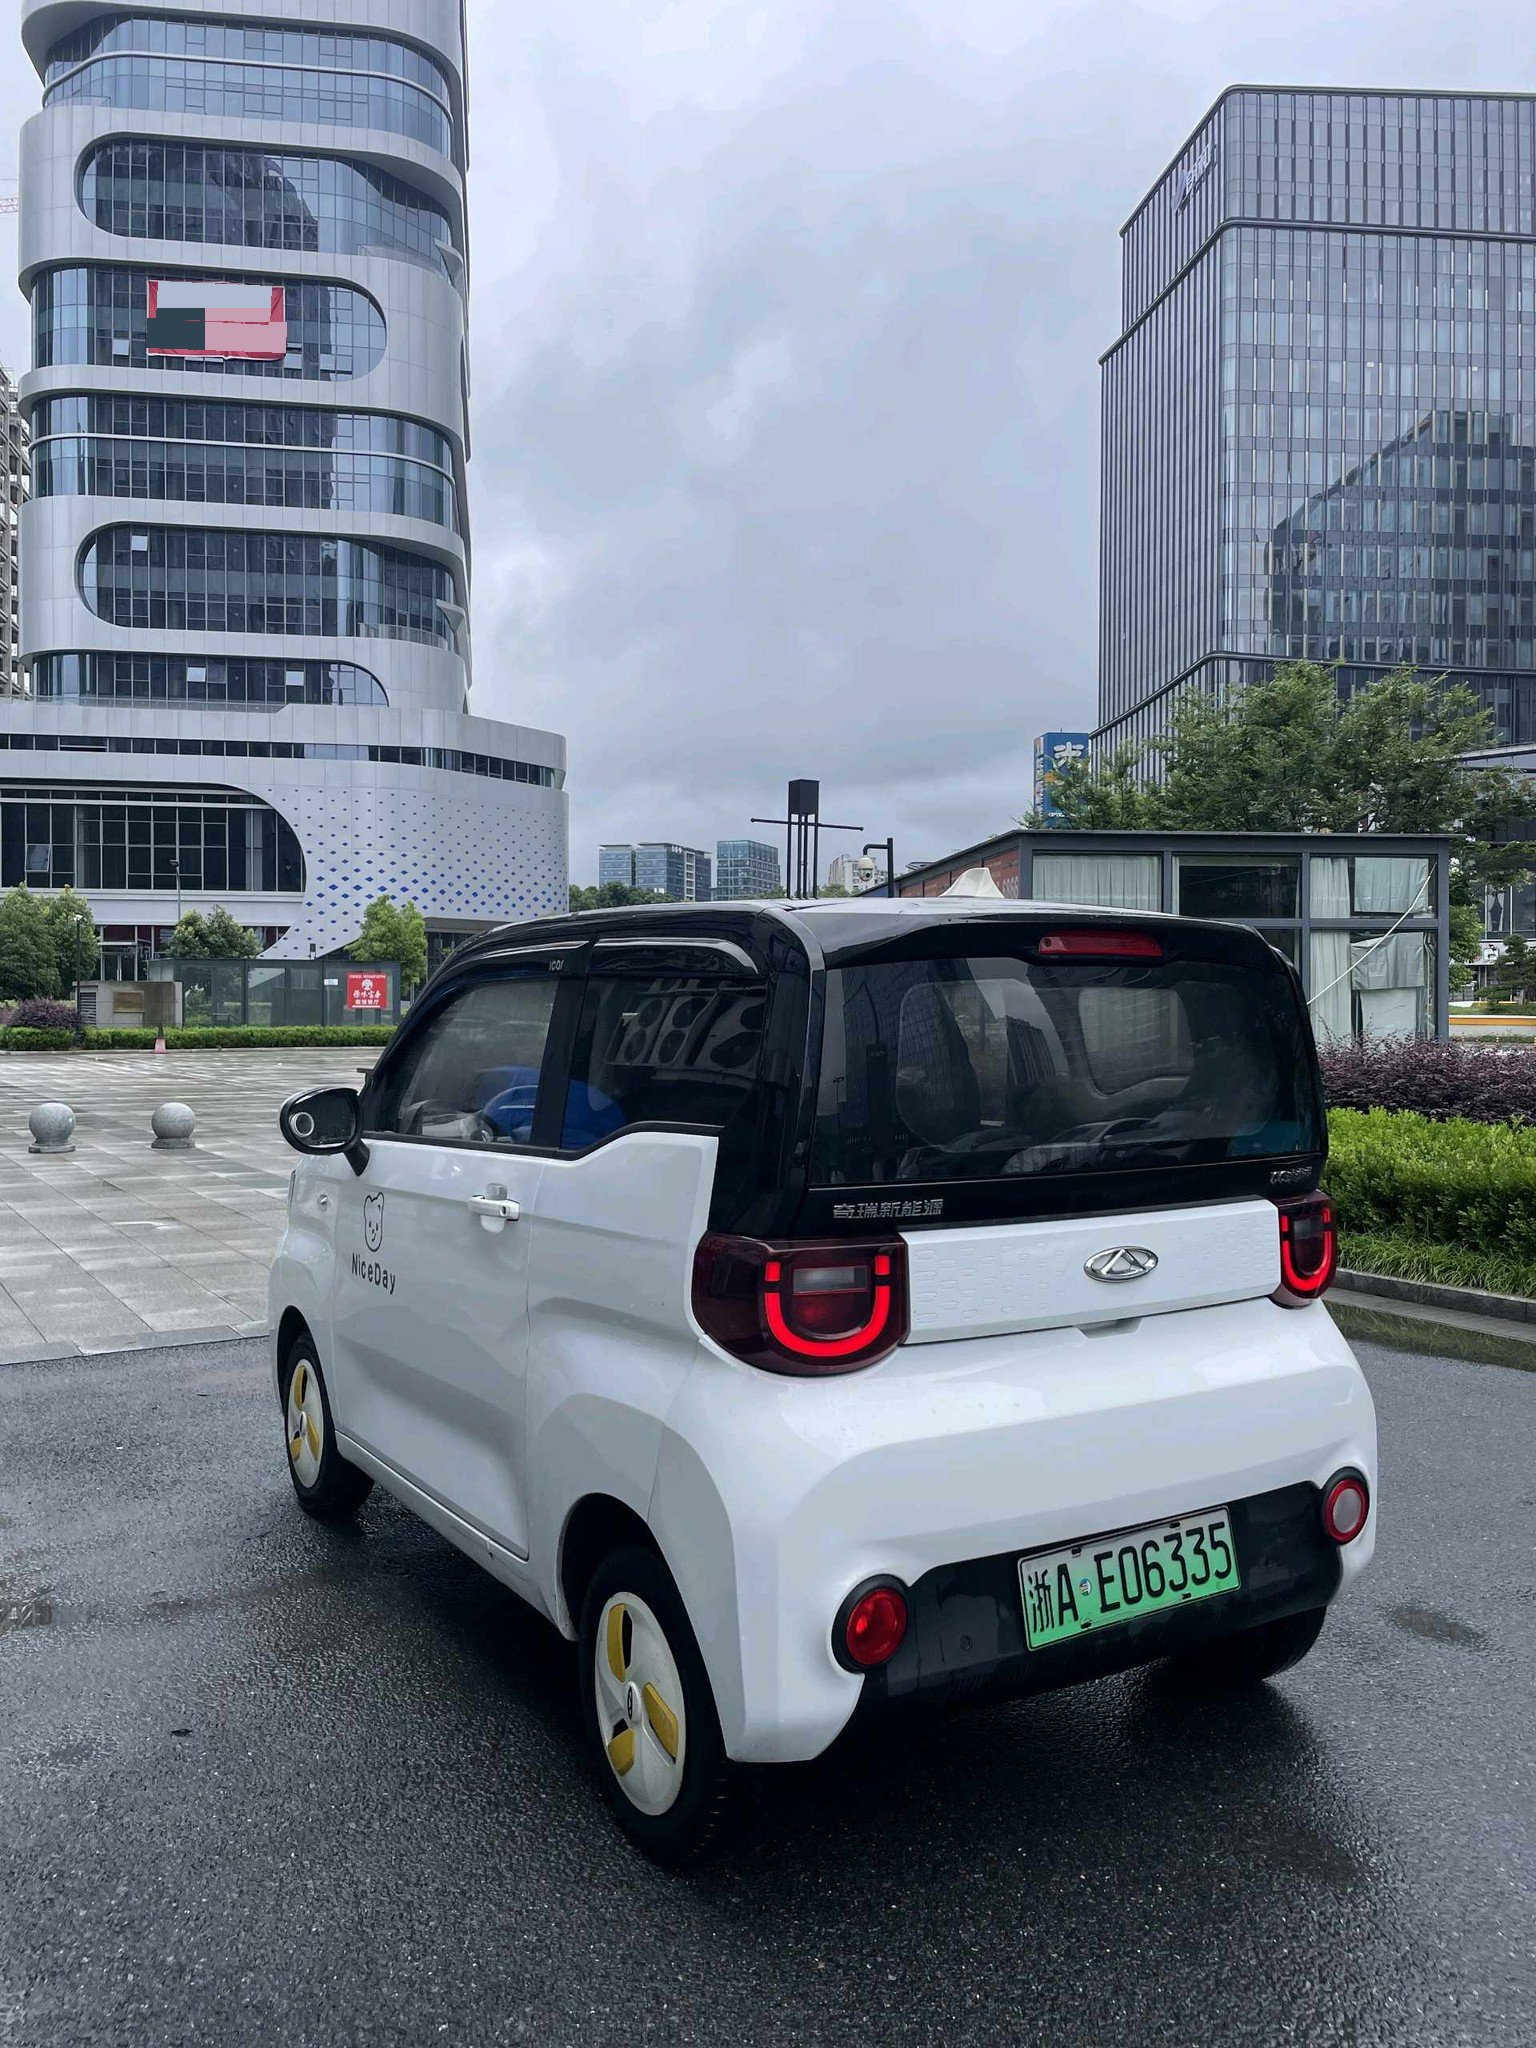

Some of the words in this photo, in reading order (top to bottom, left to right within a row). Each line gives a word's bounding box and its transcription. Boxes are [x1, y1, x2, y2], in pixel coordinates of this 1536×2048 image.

[833, 1199, 944, 1219] 奇瑞新能源
[351, 1252, 396, 1295] NiceDay
